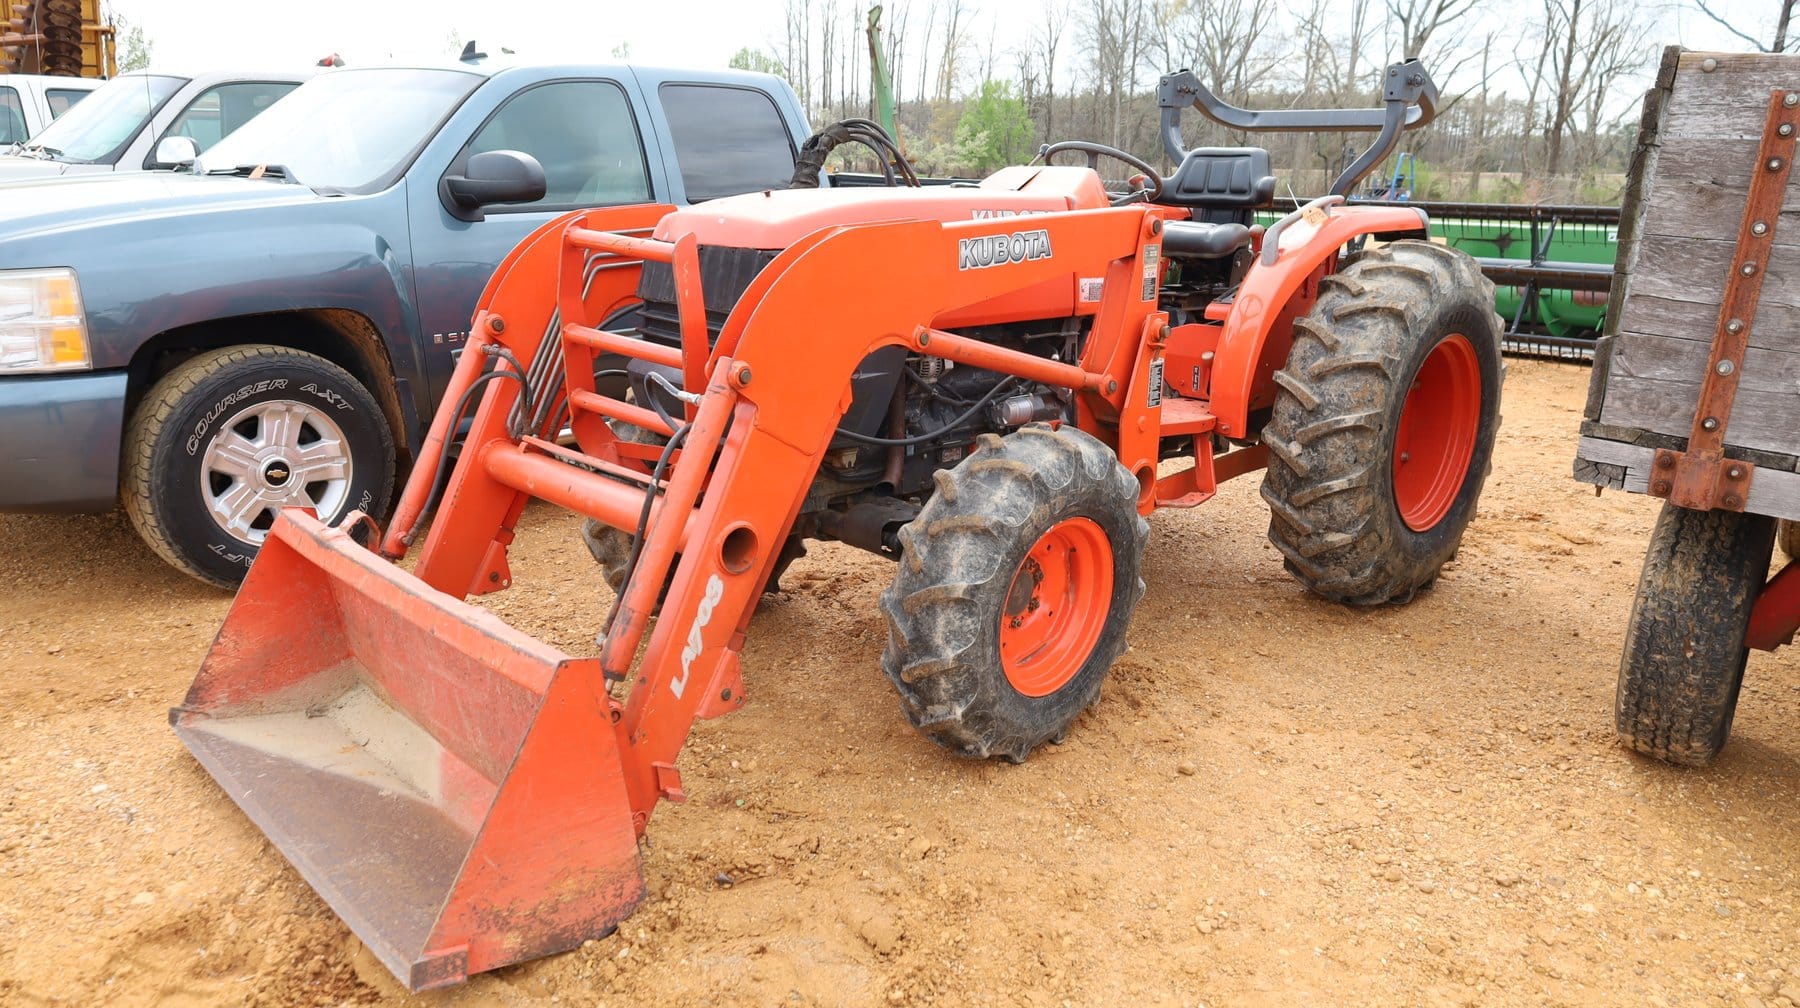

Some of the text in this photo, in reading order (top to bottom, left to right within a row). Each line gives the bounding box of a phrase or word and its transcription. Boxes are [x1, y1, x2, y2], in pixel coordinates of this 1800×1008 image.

[959, 230, 1052, 270] KUBOTA
[186, 379, 354, 456] COURSER AXT
[670, 574, 724, 700] LA703
